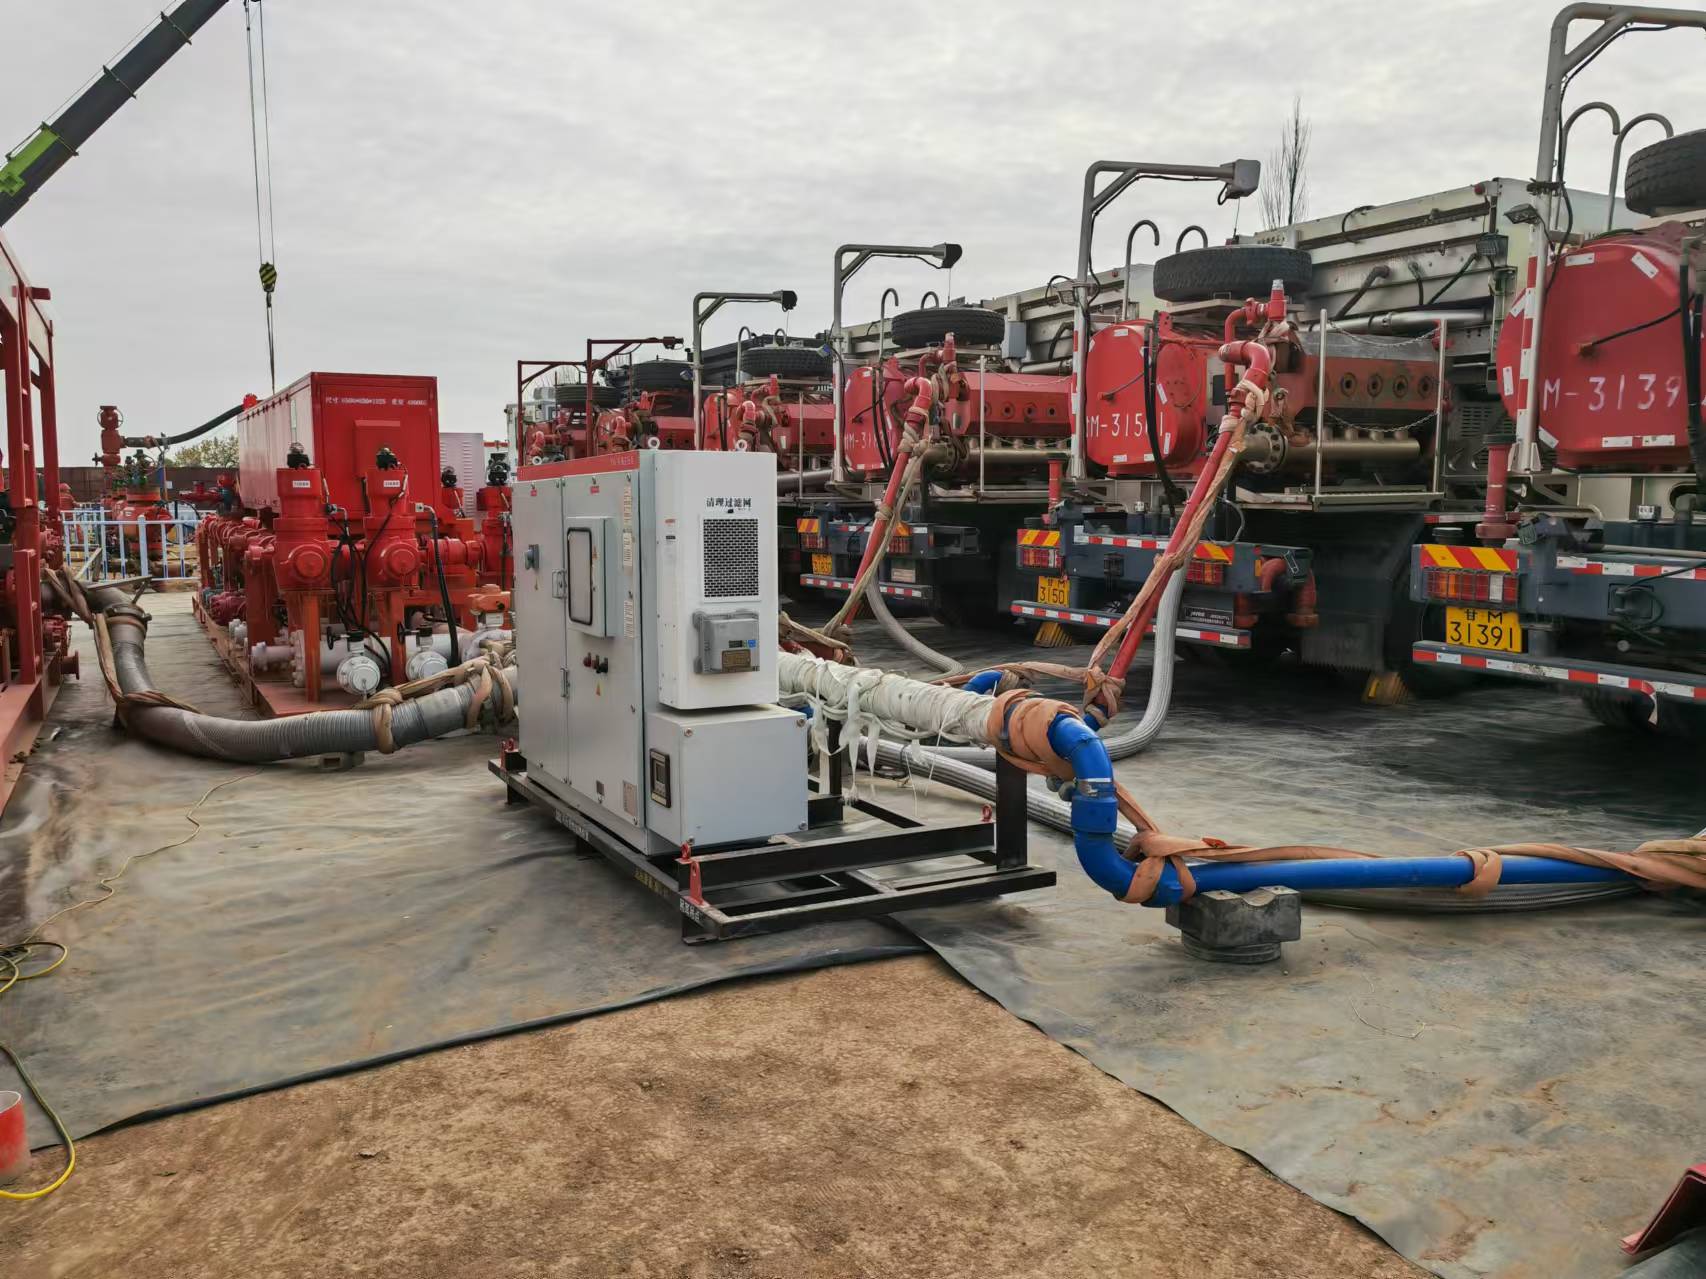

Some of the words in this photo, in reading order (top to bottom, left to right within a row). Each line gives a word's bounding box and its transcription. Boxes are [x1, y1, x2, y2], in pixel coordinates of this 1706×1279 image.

[706, 497, 752, 508] 清理过滤网
[1450, 621, 1513, 649] 31391
